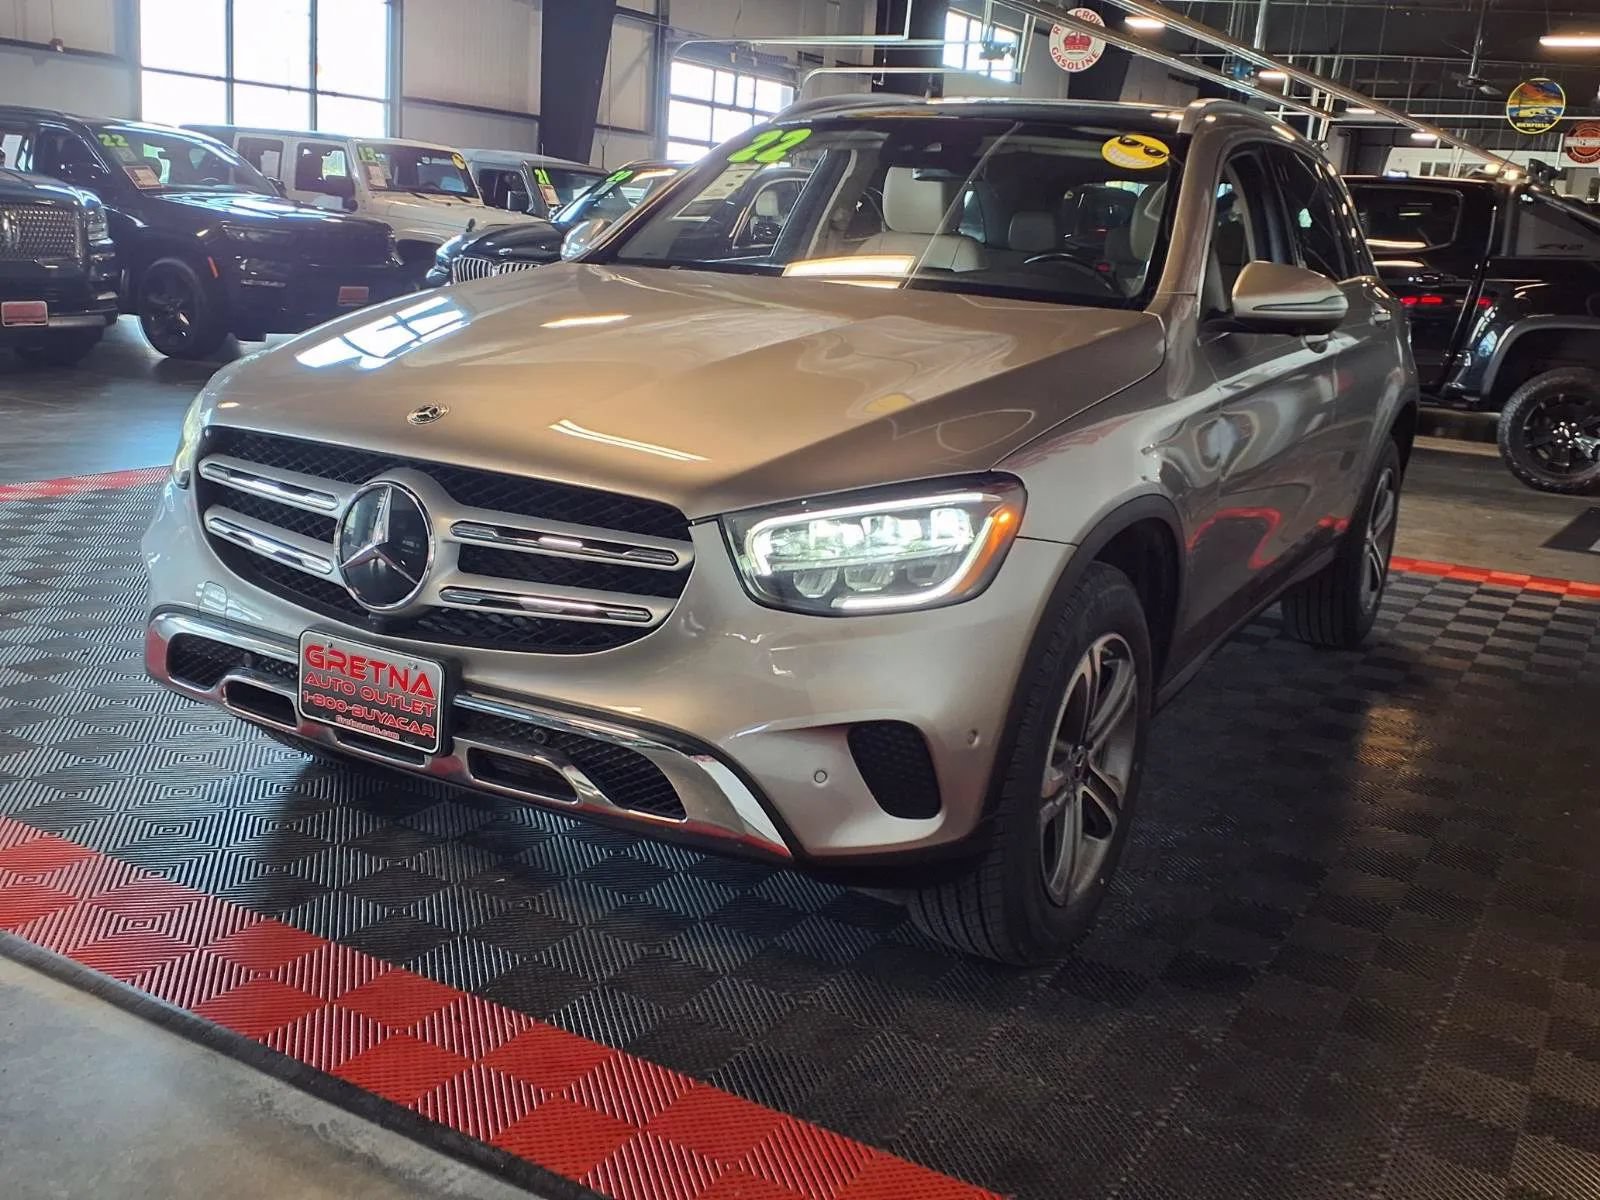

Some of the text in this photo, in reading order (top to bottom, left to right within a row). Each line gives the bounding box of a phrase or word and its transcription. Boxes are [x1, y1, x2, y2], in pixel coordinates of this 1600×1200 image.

[1051, 46, 1101, 70] GASOLINE
[97, 133, 129, 147] 22
[727, 128, 812, 163] 22
[534, 168, 551, 185] 21
[304, 644, 435, 699] GRETNA
[304, 671, 437, 718] AUTO OUTLET
[302, 690, 436, 739] 1-800-BUYACAR
